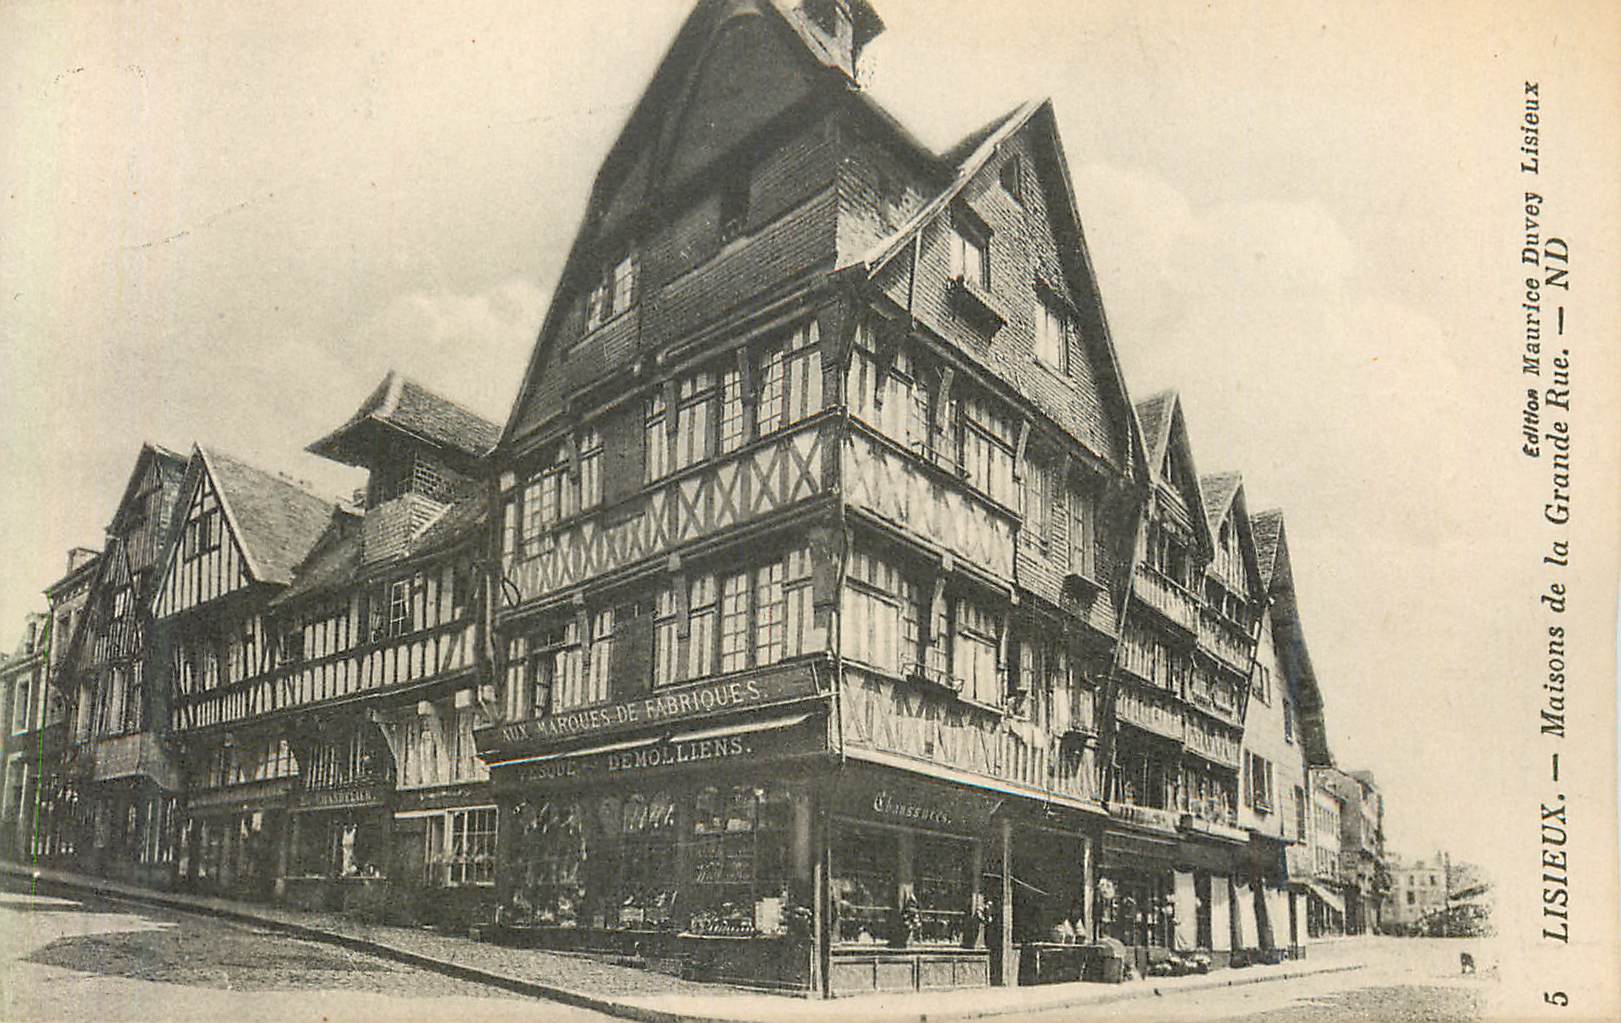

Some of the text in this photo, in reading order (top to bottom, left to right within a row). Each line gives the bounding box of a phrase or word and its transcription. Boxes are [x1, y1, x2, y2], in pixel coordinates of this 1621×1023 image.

[502, 680, 769, 743] AUX MARQUES DE FABRIQUES.
